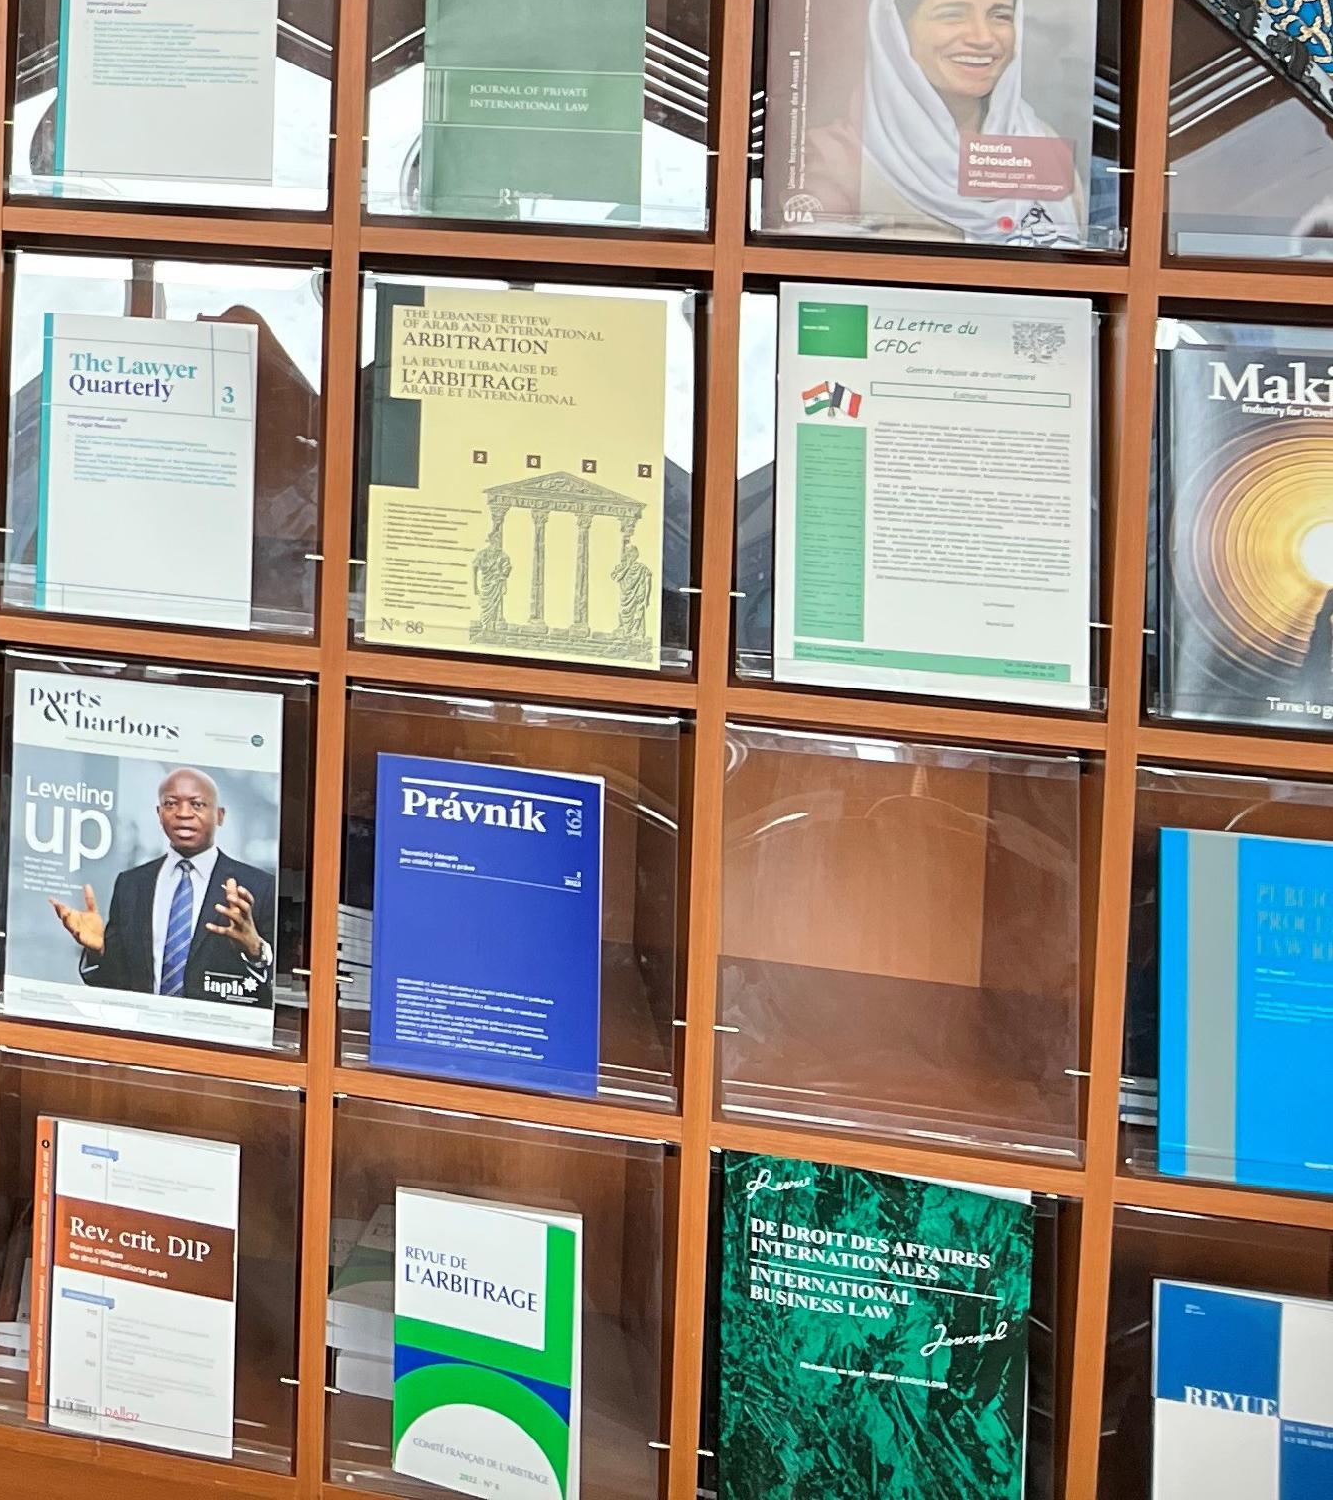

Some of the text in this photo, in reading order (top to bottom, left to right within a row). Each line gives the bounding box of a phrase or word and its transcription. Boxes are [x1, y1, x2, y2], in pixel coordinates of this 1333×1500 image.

[469, 84, 589, 99] JOURNAL OF PRIVATE
[469, 99, 590, 113] INTERNATIONAL LAW
[968, 154, 1033, 167] Sotoudeh
[784, 210, 815, 223] UIA
[403, 319, 604, 342] OF ARAB AND INTERNATIONAL
[404, 309, 551, 326] THE LEBANESE REVIEW
[874, 315, 979, 336] La Lettre du
[403, 331, 549, 355] ARBITRATION
[874, 338, 922, 355] CFDC
[69, 352, 198, 382] The Lawyer
[402, 356, 558, 377] LA REVUE LIBANAISE DE
[68, 374, 174, 403] Quarterly
[221, 386, 234, 404] 3
[447, 387, 577, 407] ET INTERNATIONAL
[1241, 404, 1302, 418] Industry for
[406, 619, 425, 635] 86
[75, 710, 180, 741] harbors
[26, 775, 114, 807] Leveling
[401, 786, 547, 833] Právník
[565, 807, 583, 838] 162
[24, 801, 113, 873] up
[69, 1215, 211, 1263] Rev. crit. DIP
[750, 1217, 991, 1270] DE DROIT DES AFFAIRES
[405, 1244, 468, 1272] REVUE DE
[749, 1237, 941, 1281] INTERNATIONALES
[404, 1264, 539, 1313] L'ARBITRAGE
[749, 1265, 915, 1306] INTERNATIONAL
[749, 1285, 894, 1321] BUSINESS LAW
[1183, 1385, 1280, 1418] REVUE
